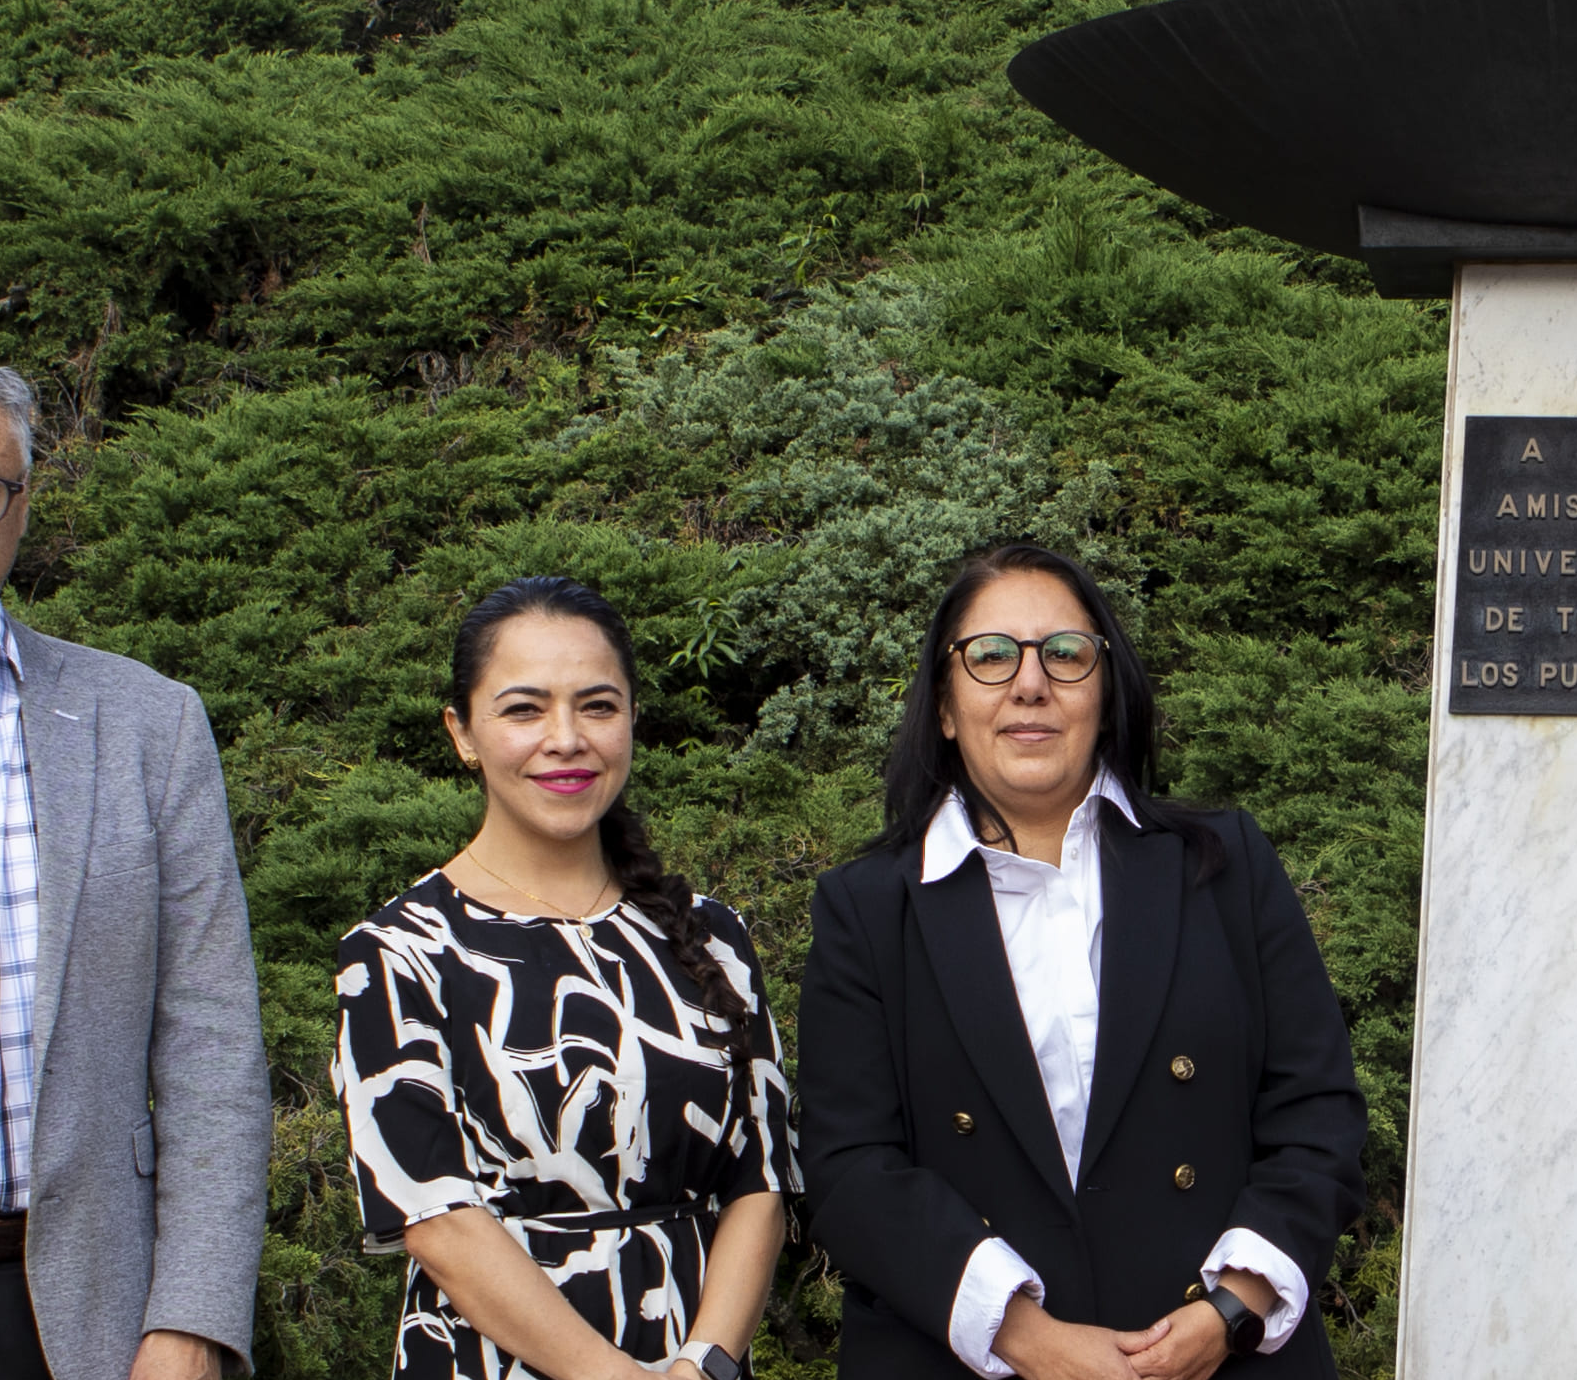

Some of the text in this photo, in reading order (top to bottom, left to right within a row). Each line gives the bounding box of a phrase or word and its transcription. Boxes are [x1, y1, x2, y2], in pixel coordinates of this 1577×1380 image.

[1521, 438, 1543, 461] A
[1486, 607, 1523, 630] DE
[1461, 661, 1518, 685] LOS
